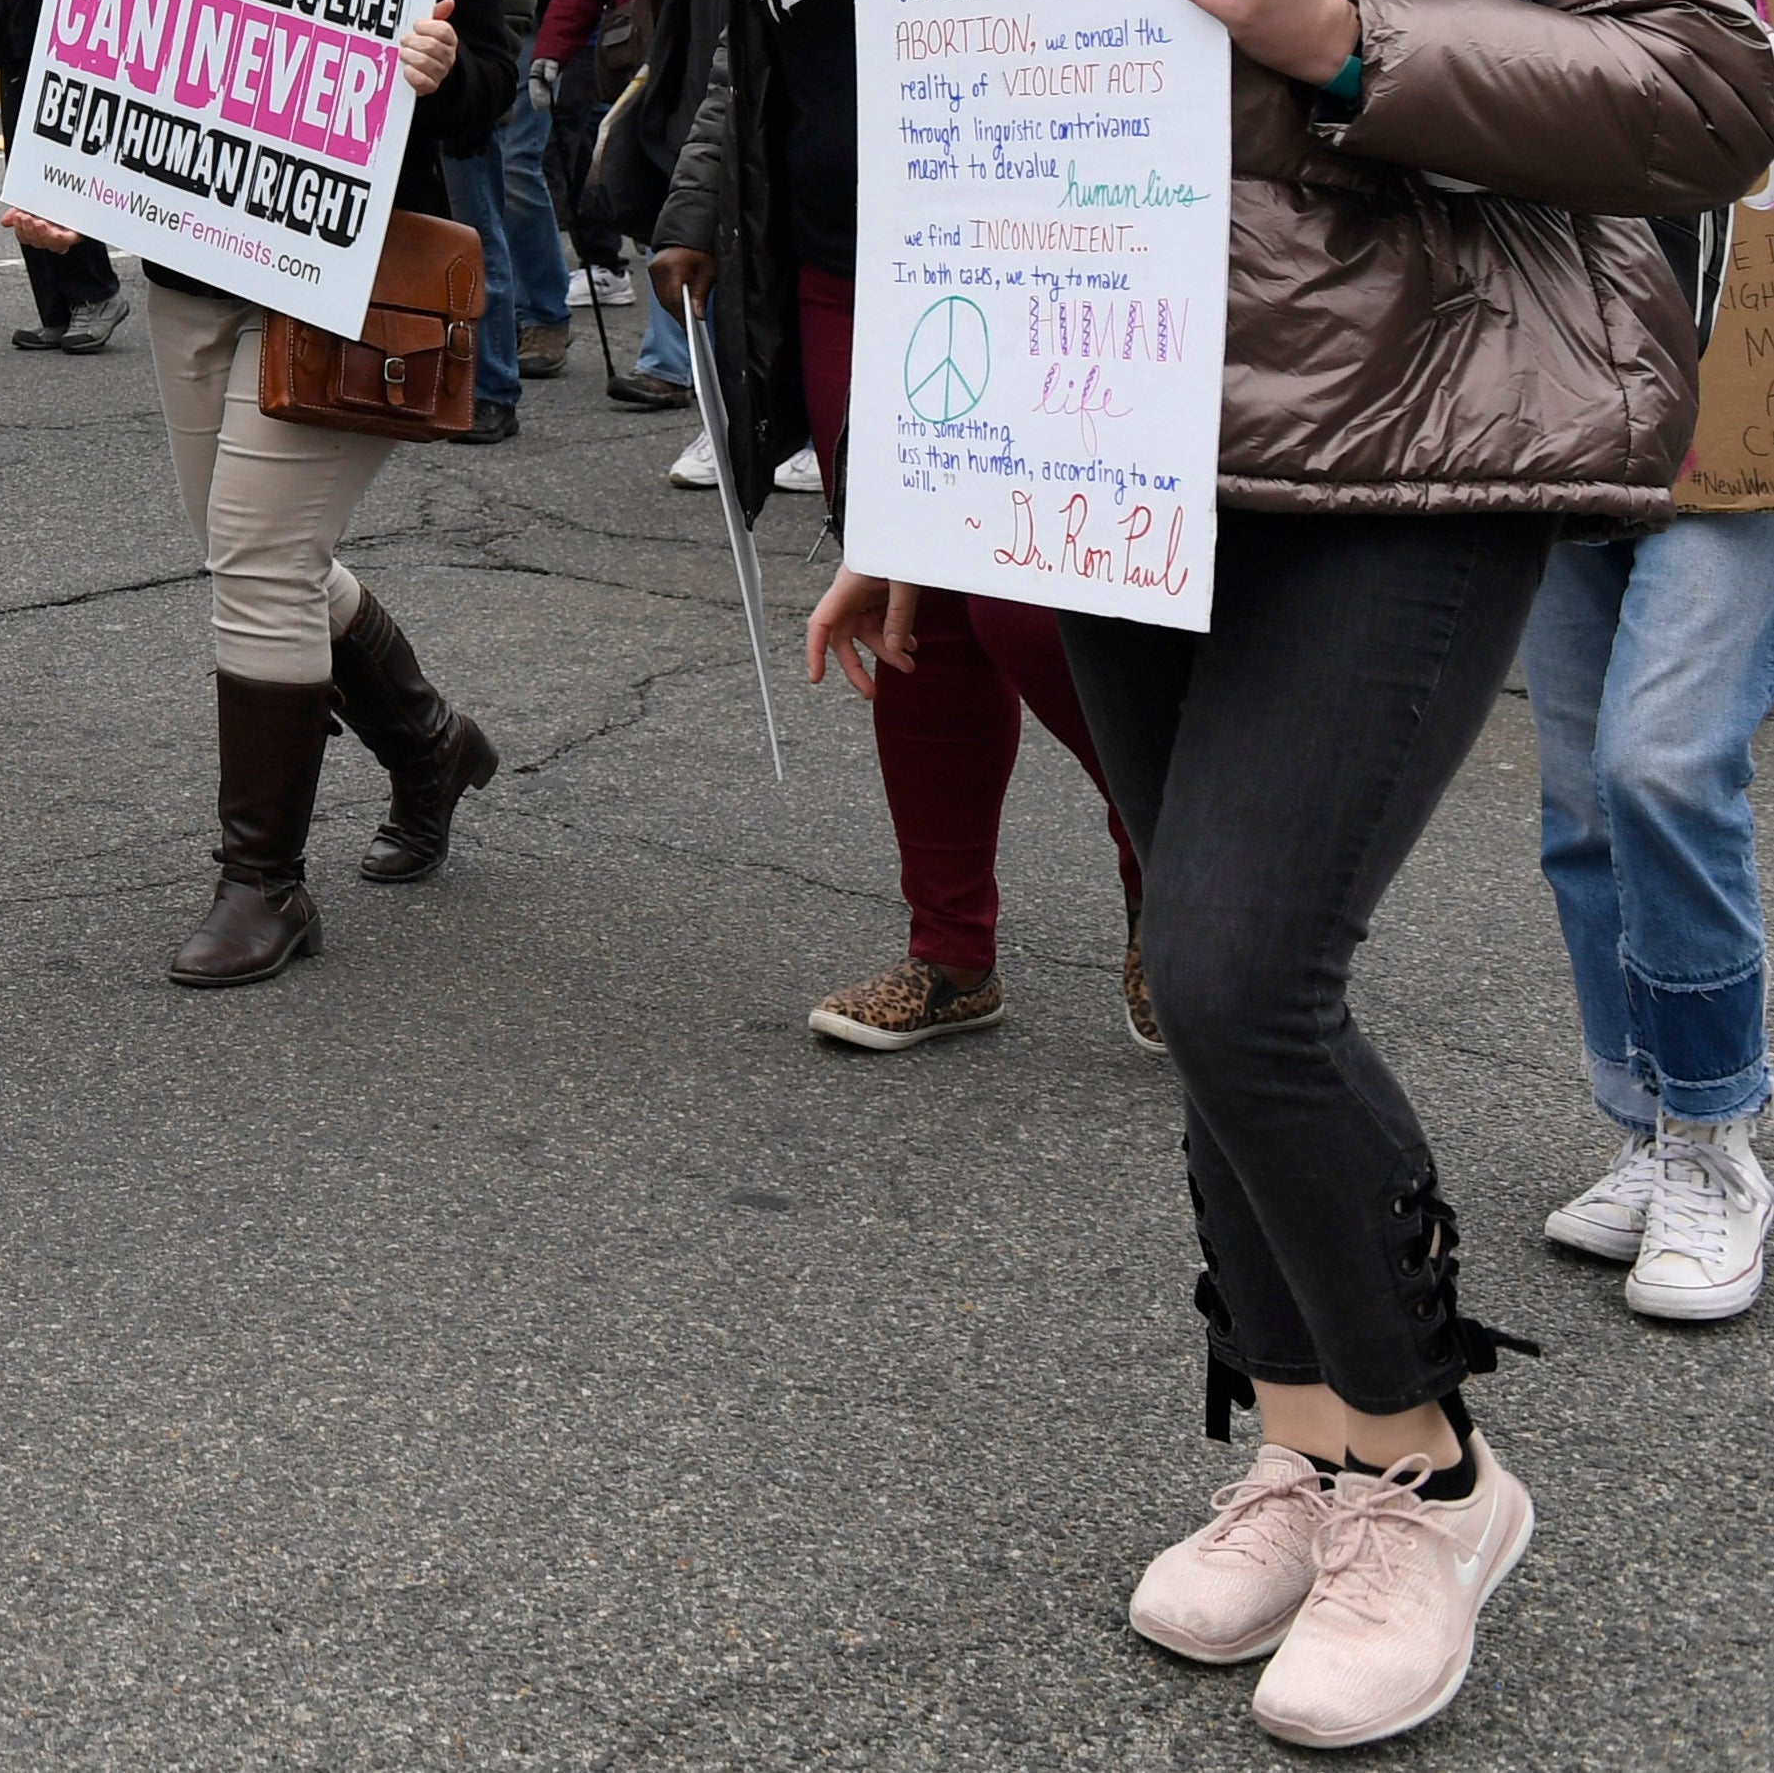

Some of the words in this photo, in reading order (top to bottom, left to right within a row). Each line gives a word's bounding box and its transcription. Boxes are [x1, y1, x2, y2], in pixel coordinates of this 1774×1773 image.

[896, 13, 1037, 61] ABORTION,
[1045, 35, 1069, 52] we
[1075, 19, 1129, 49] conceal
[1134, 18, 1173, 46] the
[186, 5, 380, 143] NEVER
[900, 73, 965, 112] reality
[972, 73, 989, 97] of
[1002, 63, 1101, 97] VIOLENT
[1107, 60, 1164, 94] ACTS
[39, 77, 82, 134] BE
[86, 97, 110, 145] A
[122, 108, 246, 195] HUMAN
[250, 154, 369, 239] RIGHT
[899, 117, 960, 156] through
[974, 117, 1043, 160] linguistic
[907, 156, 960, 180] meant
[967, 154, 987, 179] to
[994, 153, 1061, 180] devalue
[1058, 159, 1141, 209] human
[1143, 169, 1212, 208] lives
[42, 163, 322, 286] www.NewWaveFeminists.com
[904, 231, 924, 247] we
[928, 224, 961, 247] find
[969, 219, 1149, 253] INCONVENIENT...
[892, 262, 917, 284] In
[923, 263, 953, 285] both
[959, 266, 1001, 290] cases,
[1005, 270, 1026, 286] we
[1030, 265, 1065, 303] try
[1065, 267, 1084, 287] to
[1087, 271, 1131, 291] make
[1029, 295, 1189, 362] HUMAN
[896, 414, 927, 438] into
[933, 420, 1015, 464] something
[1032, 362, 1134, 458] life
[897, 443, 921, 466] less
[925, 445, 960, 471] than
[967, 448, 1034, 482] human,
[1042, 459, 1127, 506] according
[1129, 462, 1148, 487] to
[1154, 474, 1181, 493] our
[994, 490, 1053, 572] Dr.
[1059, 493, 1114, 583] Ron
[1118, 505, 1189, 596] Paul
